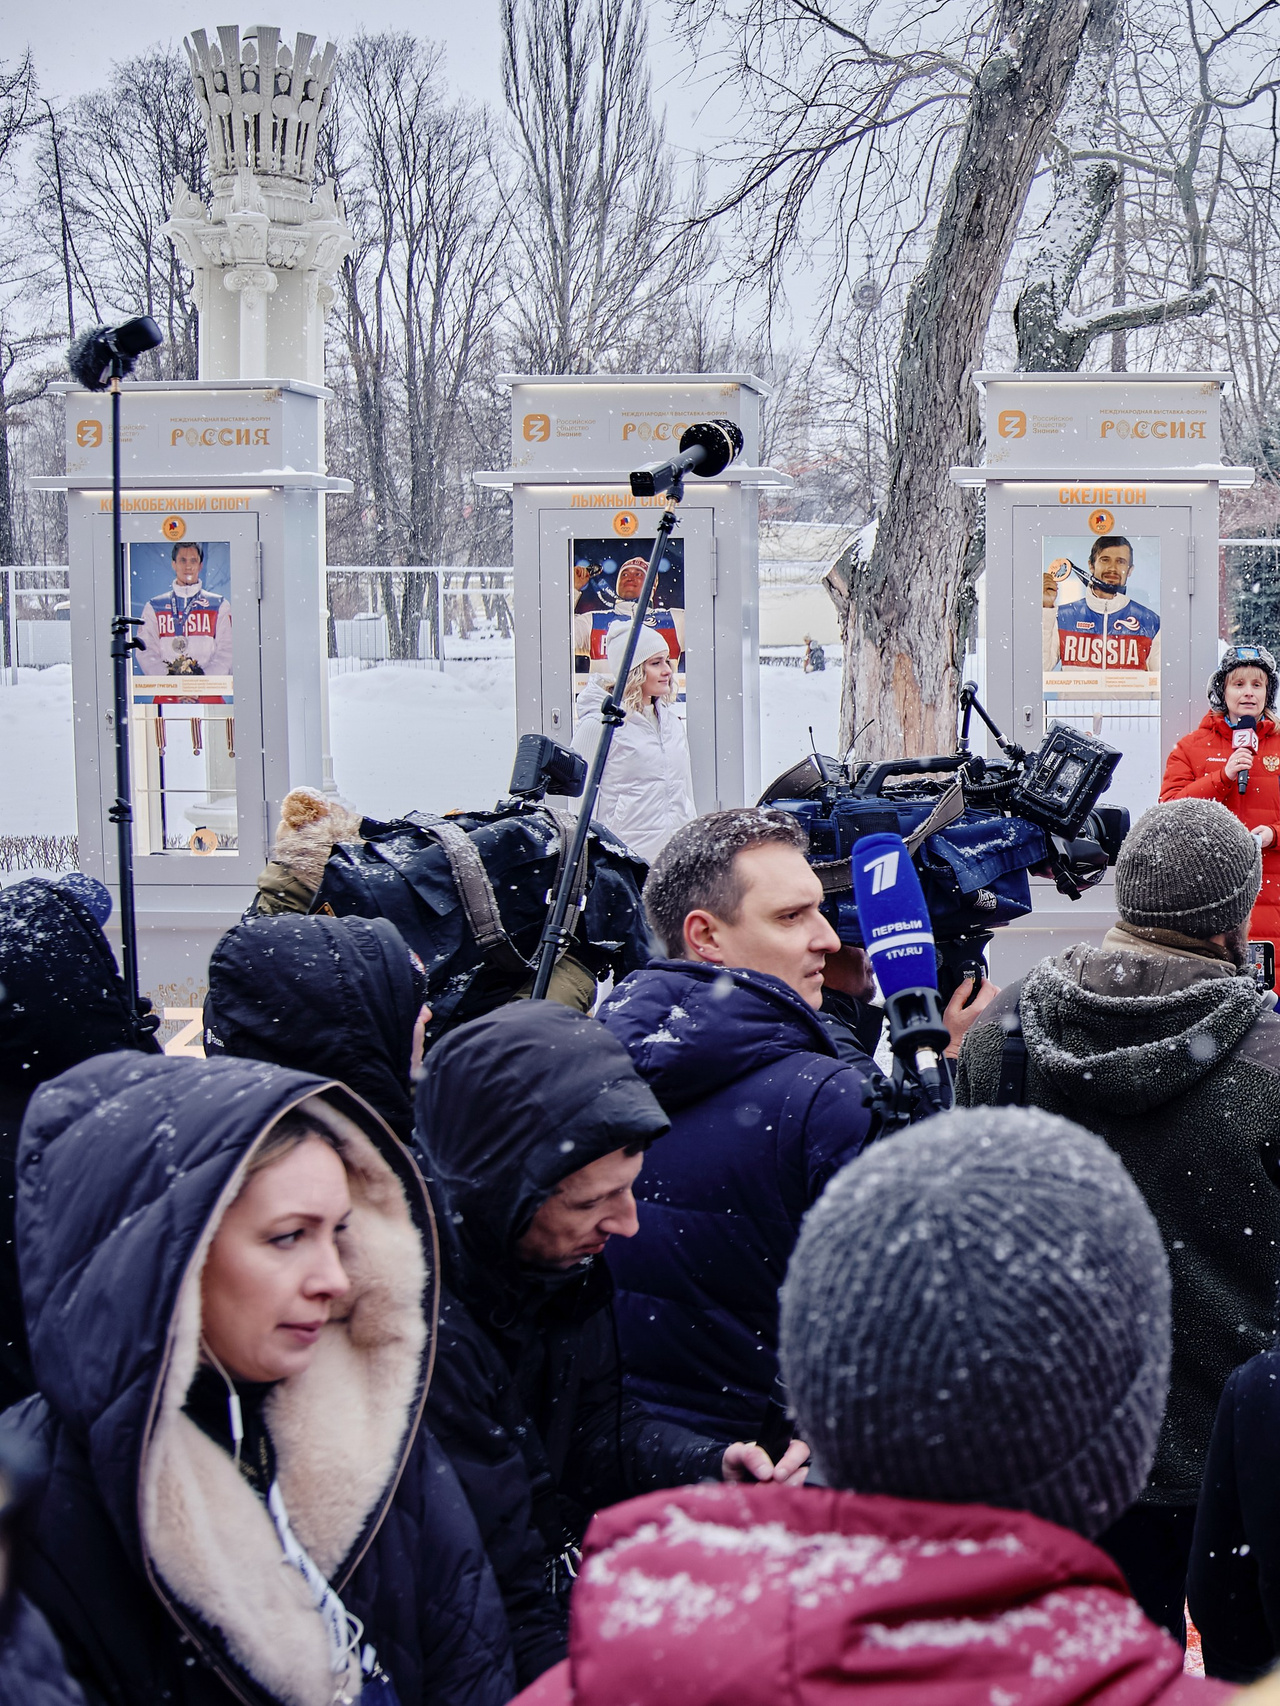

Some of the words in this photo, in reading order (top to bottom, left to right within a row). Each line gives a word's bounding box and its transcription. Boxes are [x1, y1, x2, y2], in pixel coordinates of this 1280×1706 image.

[170, 428, 270, 447] РОССИЯ
[621, 422, 695, 441] РОСС
[1099, 419, 1207, 439] РОССИЯ
[211, 496, 252, 511] СПОРТ
[1058, 487, 1147, 505] СКЕЛЕТОН
[158, 613, 211, 634] RUSIA
[1064, 635, 1139, 666] RUSSIA
[885, 946, 923, 961] 1TV.RU
